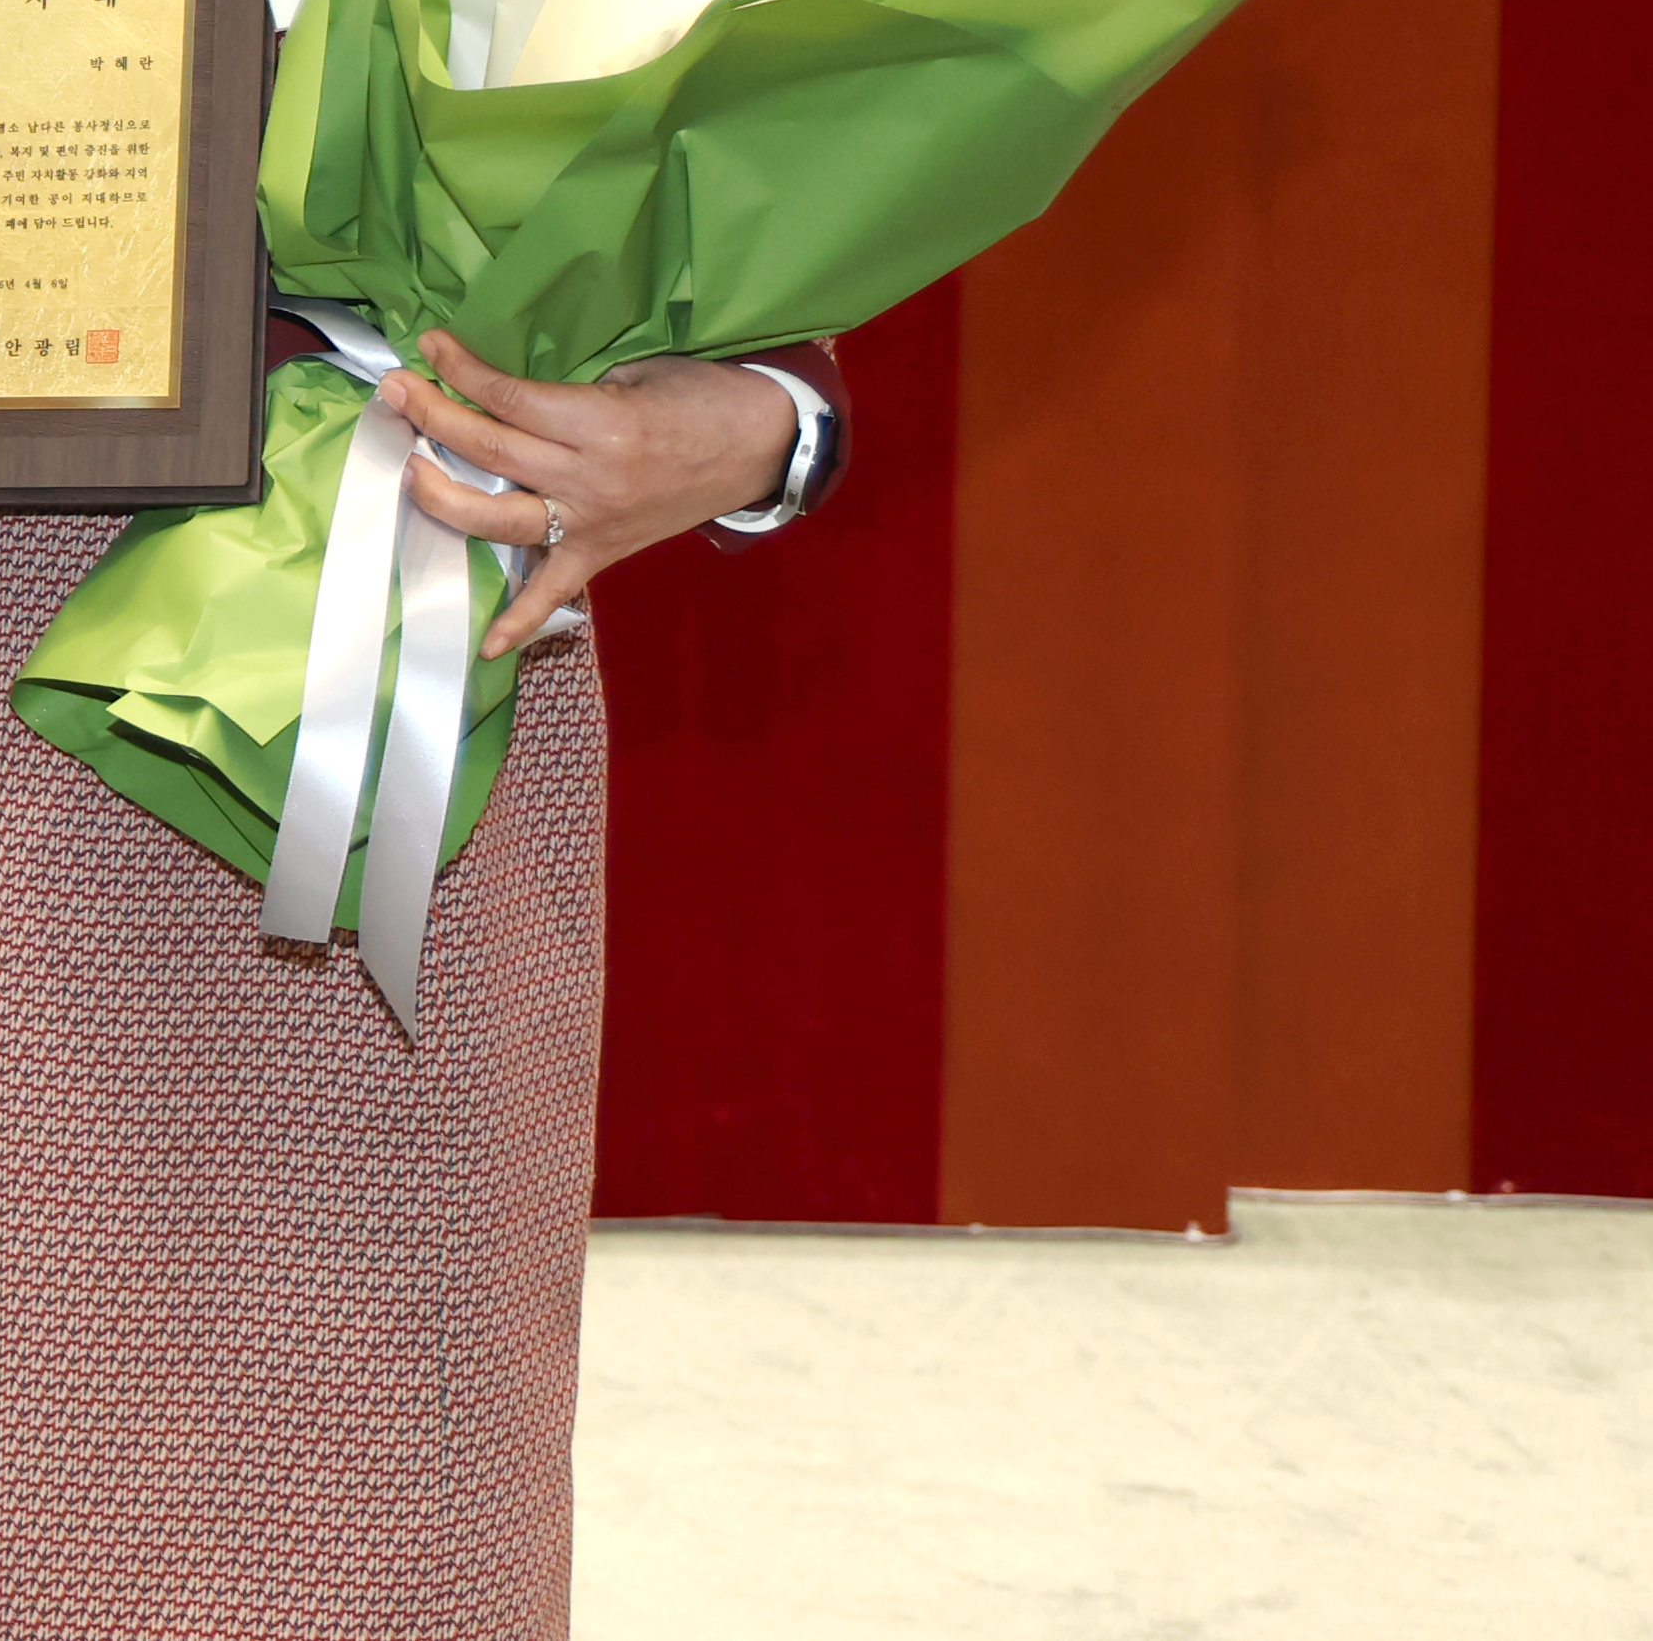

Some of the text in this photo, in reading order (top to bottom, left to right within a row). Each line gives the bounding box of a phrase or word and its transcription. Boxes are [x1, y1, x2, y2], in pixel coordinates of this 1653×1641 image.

[28, 120, 65, 133] 남다른
[73, 119, 151, 133] 봉사정신으로
[9, 145, 32, 158] 복지
[39, 145, 49, 157] 및
[56, 144, 78, 157] 편익
[84, 143, 120, 157] 증진을
[127, 142, 150, 155] 위한
[2, 169, 25, 182] 주민
[31, 168, 78, 181] 자치활동
[84, 167, 120, 180] 강화와
[125, 167, 148, 179] 지역
[1, 193, 39, 206] 기여한
[48, 192, 73, 205] 공이
[82, 192, 147, 205] 지대하므로
[34, 216, 56, 229] 담아
[62, 216, 114, 229] 드립니다.
[24, 278, 42, 289] 4월
[51, 277, 68, 289] 6일
